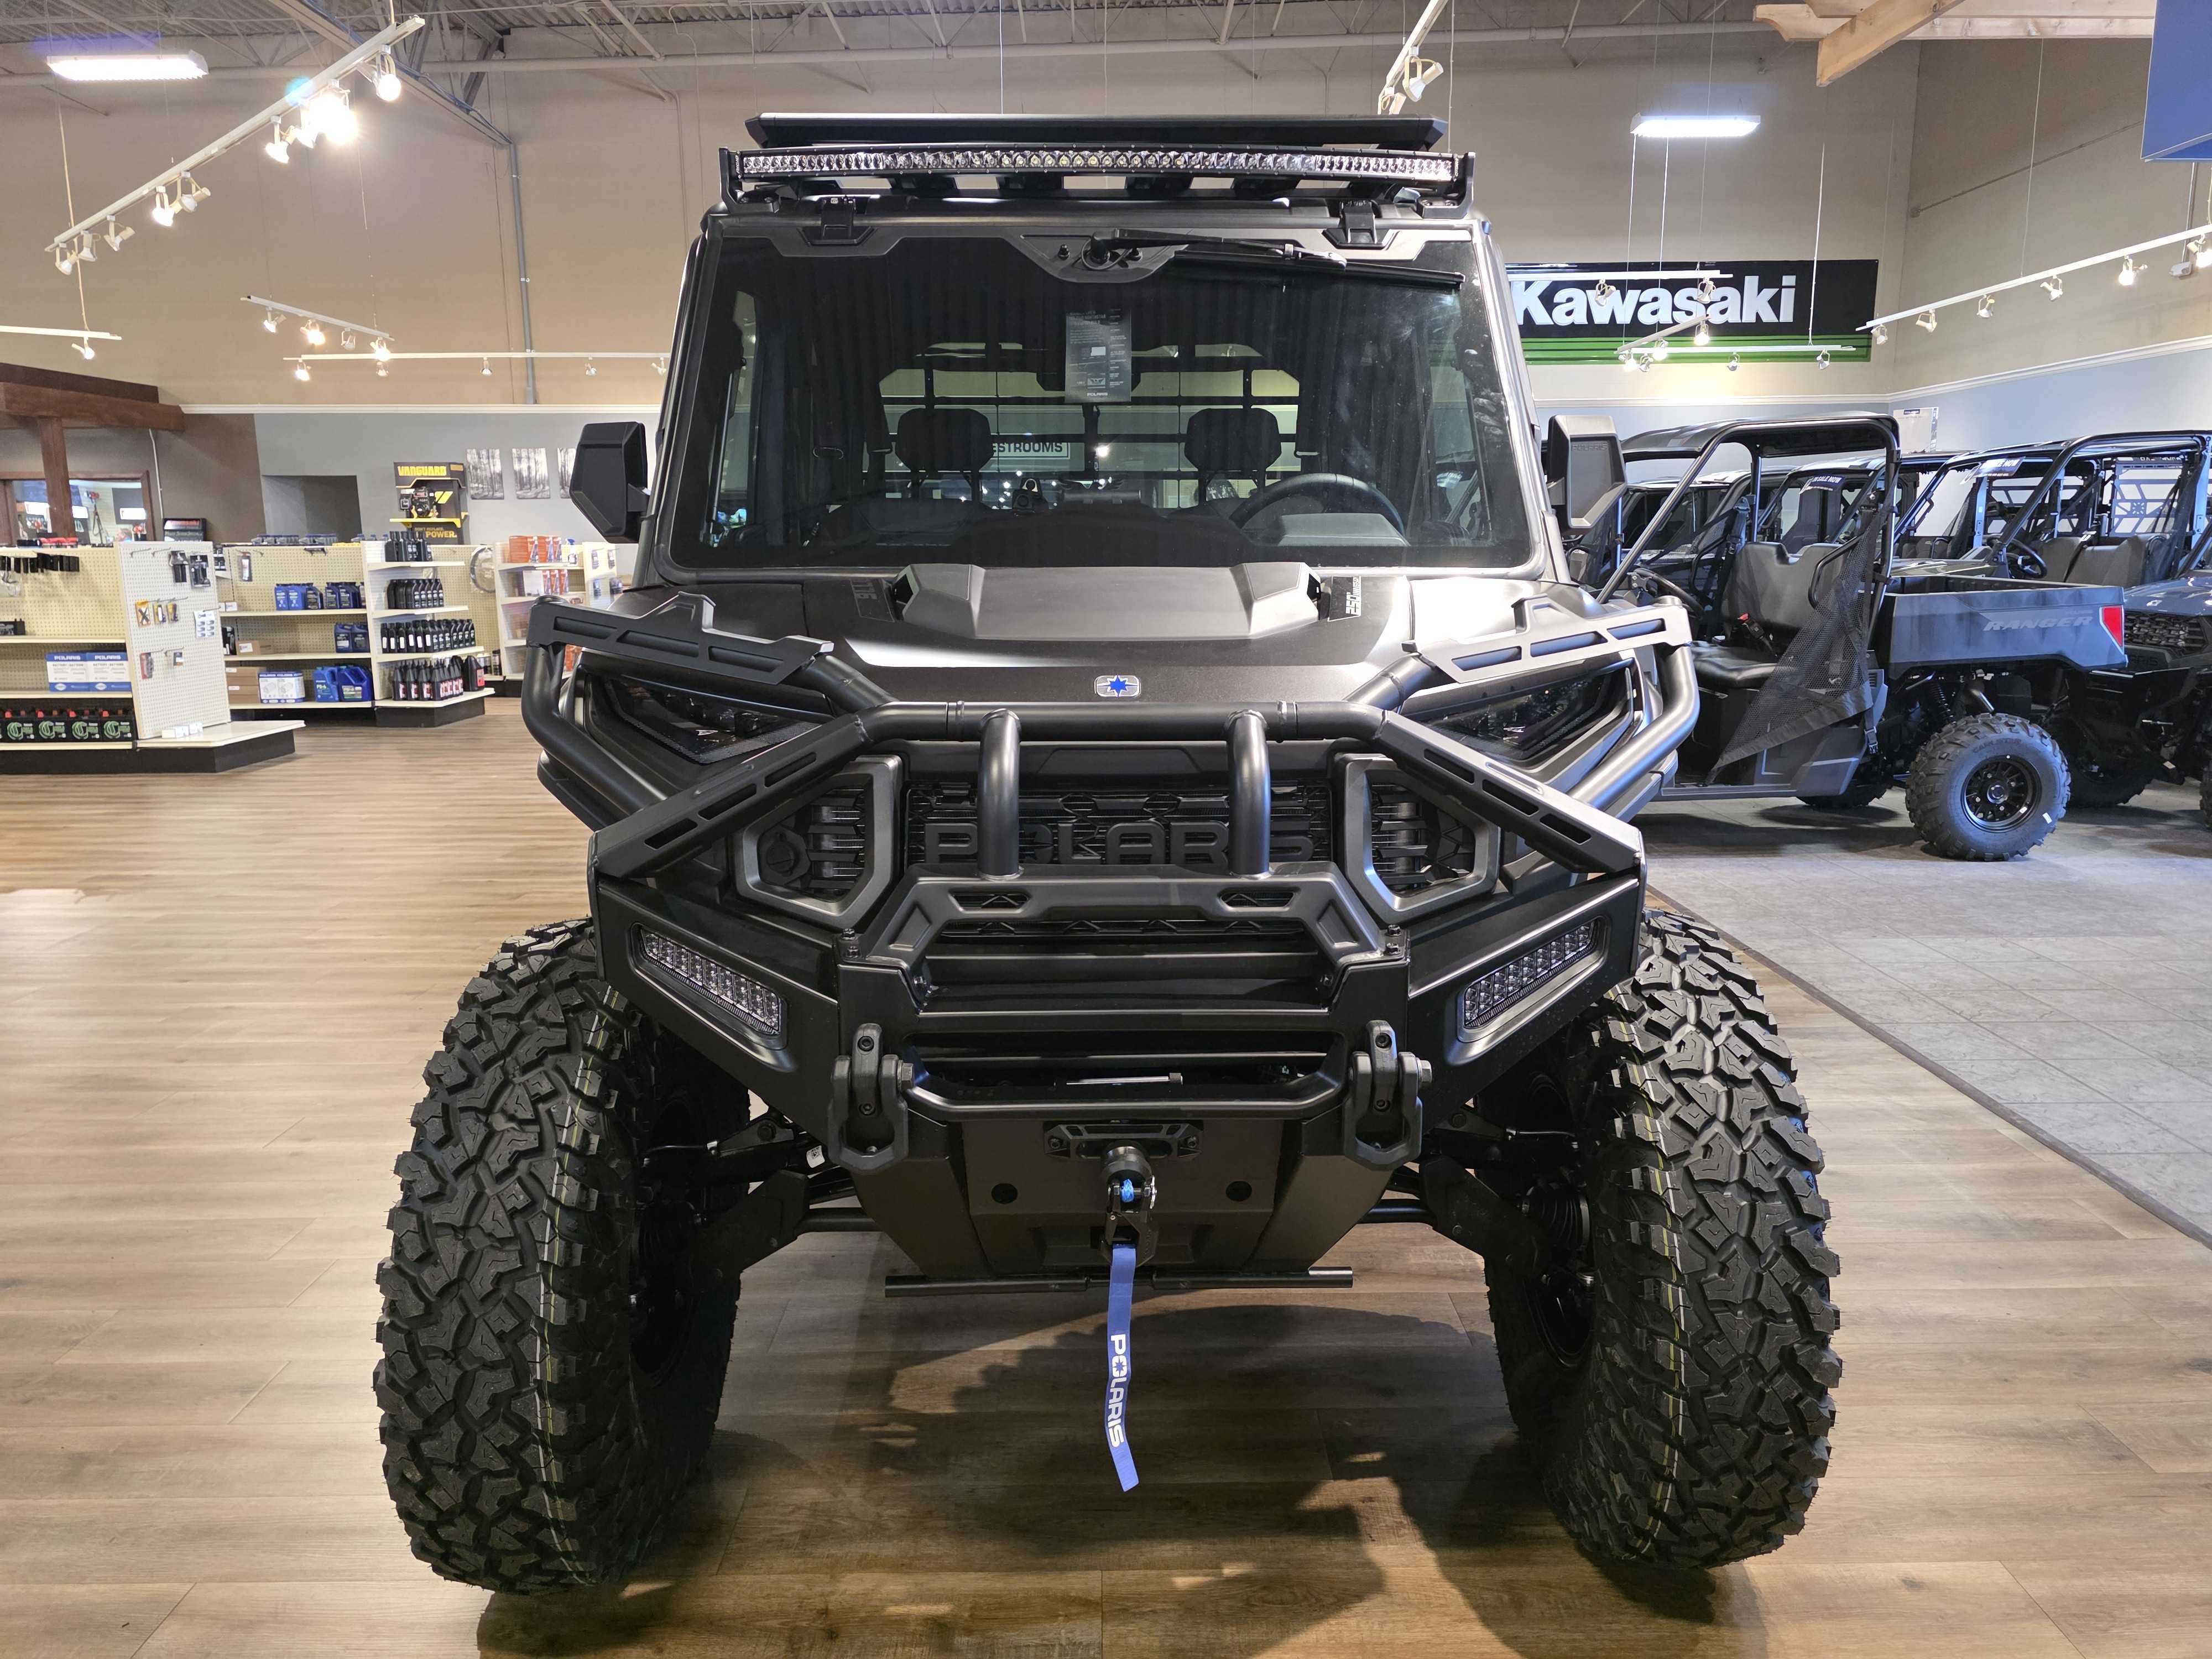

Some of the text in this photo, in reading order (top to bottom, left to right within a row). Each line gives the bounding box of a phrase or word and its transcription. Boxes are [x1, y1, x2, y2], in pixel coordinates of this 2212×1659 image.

[1511, 275, 1796, 326] Kawasaki
[992, 442, 1062, 452] ESTROOMS
[398, 466, 447, 476] VANGUARD
[1983, 616, 2093, 632] RANGER
[1108, 1334, 1128, 1448] POLARIS
